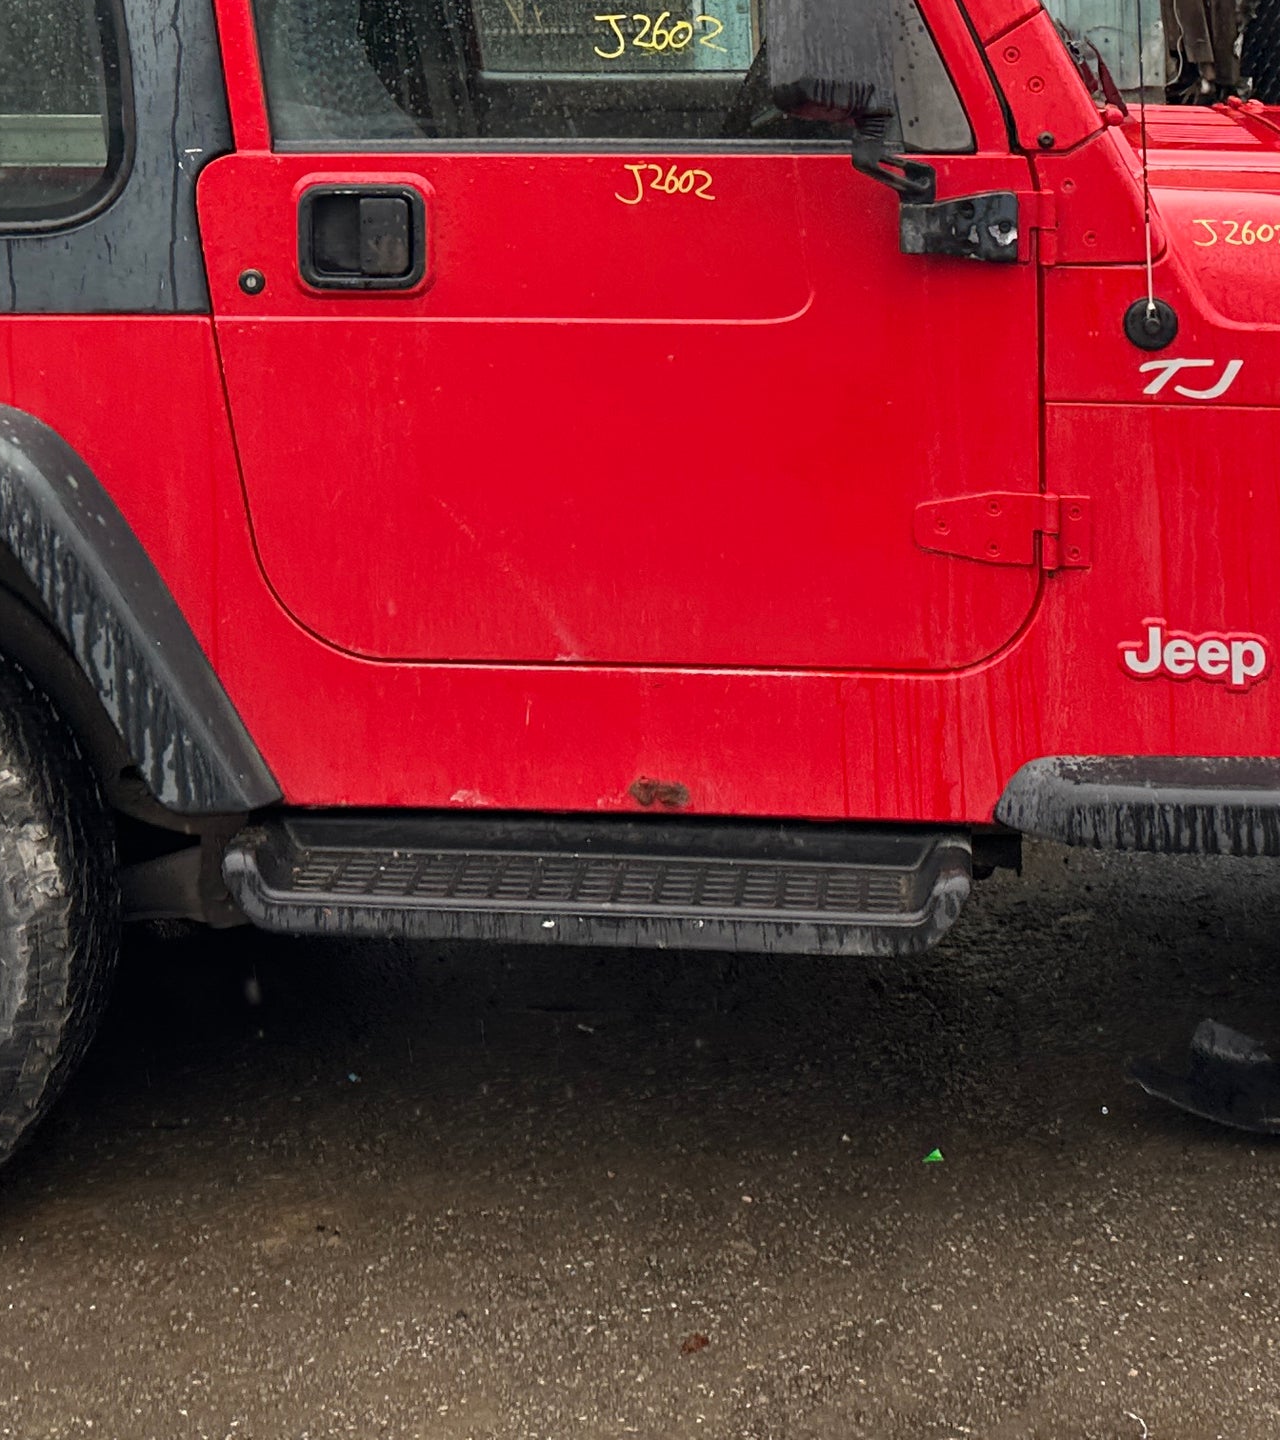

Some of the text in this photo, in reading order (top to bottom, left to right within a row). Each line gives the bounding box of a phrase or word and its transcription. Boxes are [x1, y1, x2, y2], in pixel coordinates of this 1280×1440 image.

[594, 11, 728, 58] J2602
[614, 164, 715, 205] J2602
[1139, 358, 1244, 399] TJ
[1124, 626, 1266, 685] Jeep
